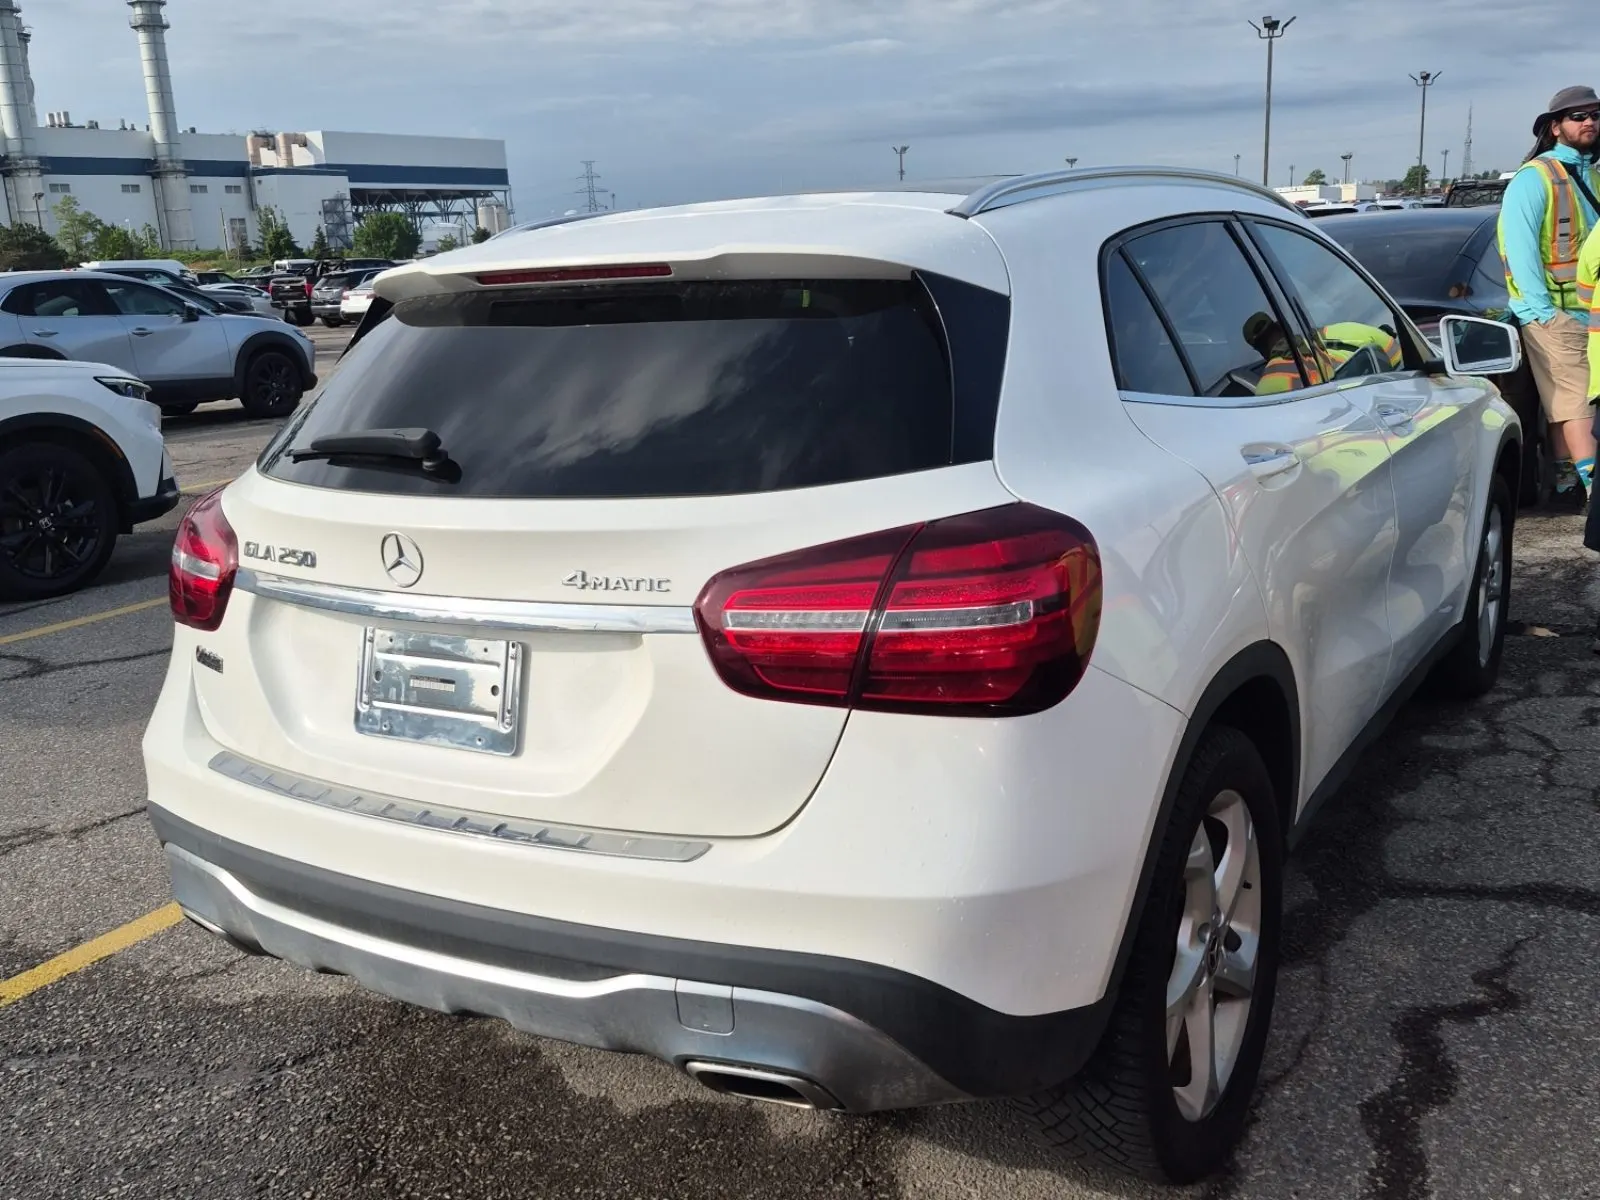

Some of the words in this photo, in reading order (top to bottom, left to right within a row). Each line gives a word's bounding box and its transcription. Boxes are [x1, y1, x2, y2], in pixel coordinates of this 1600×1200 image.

[243, 540, 276, 562] GLA
[278, 546, 318, 569] 250
[561, 569, 672, 593] 4MATIC
